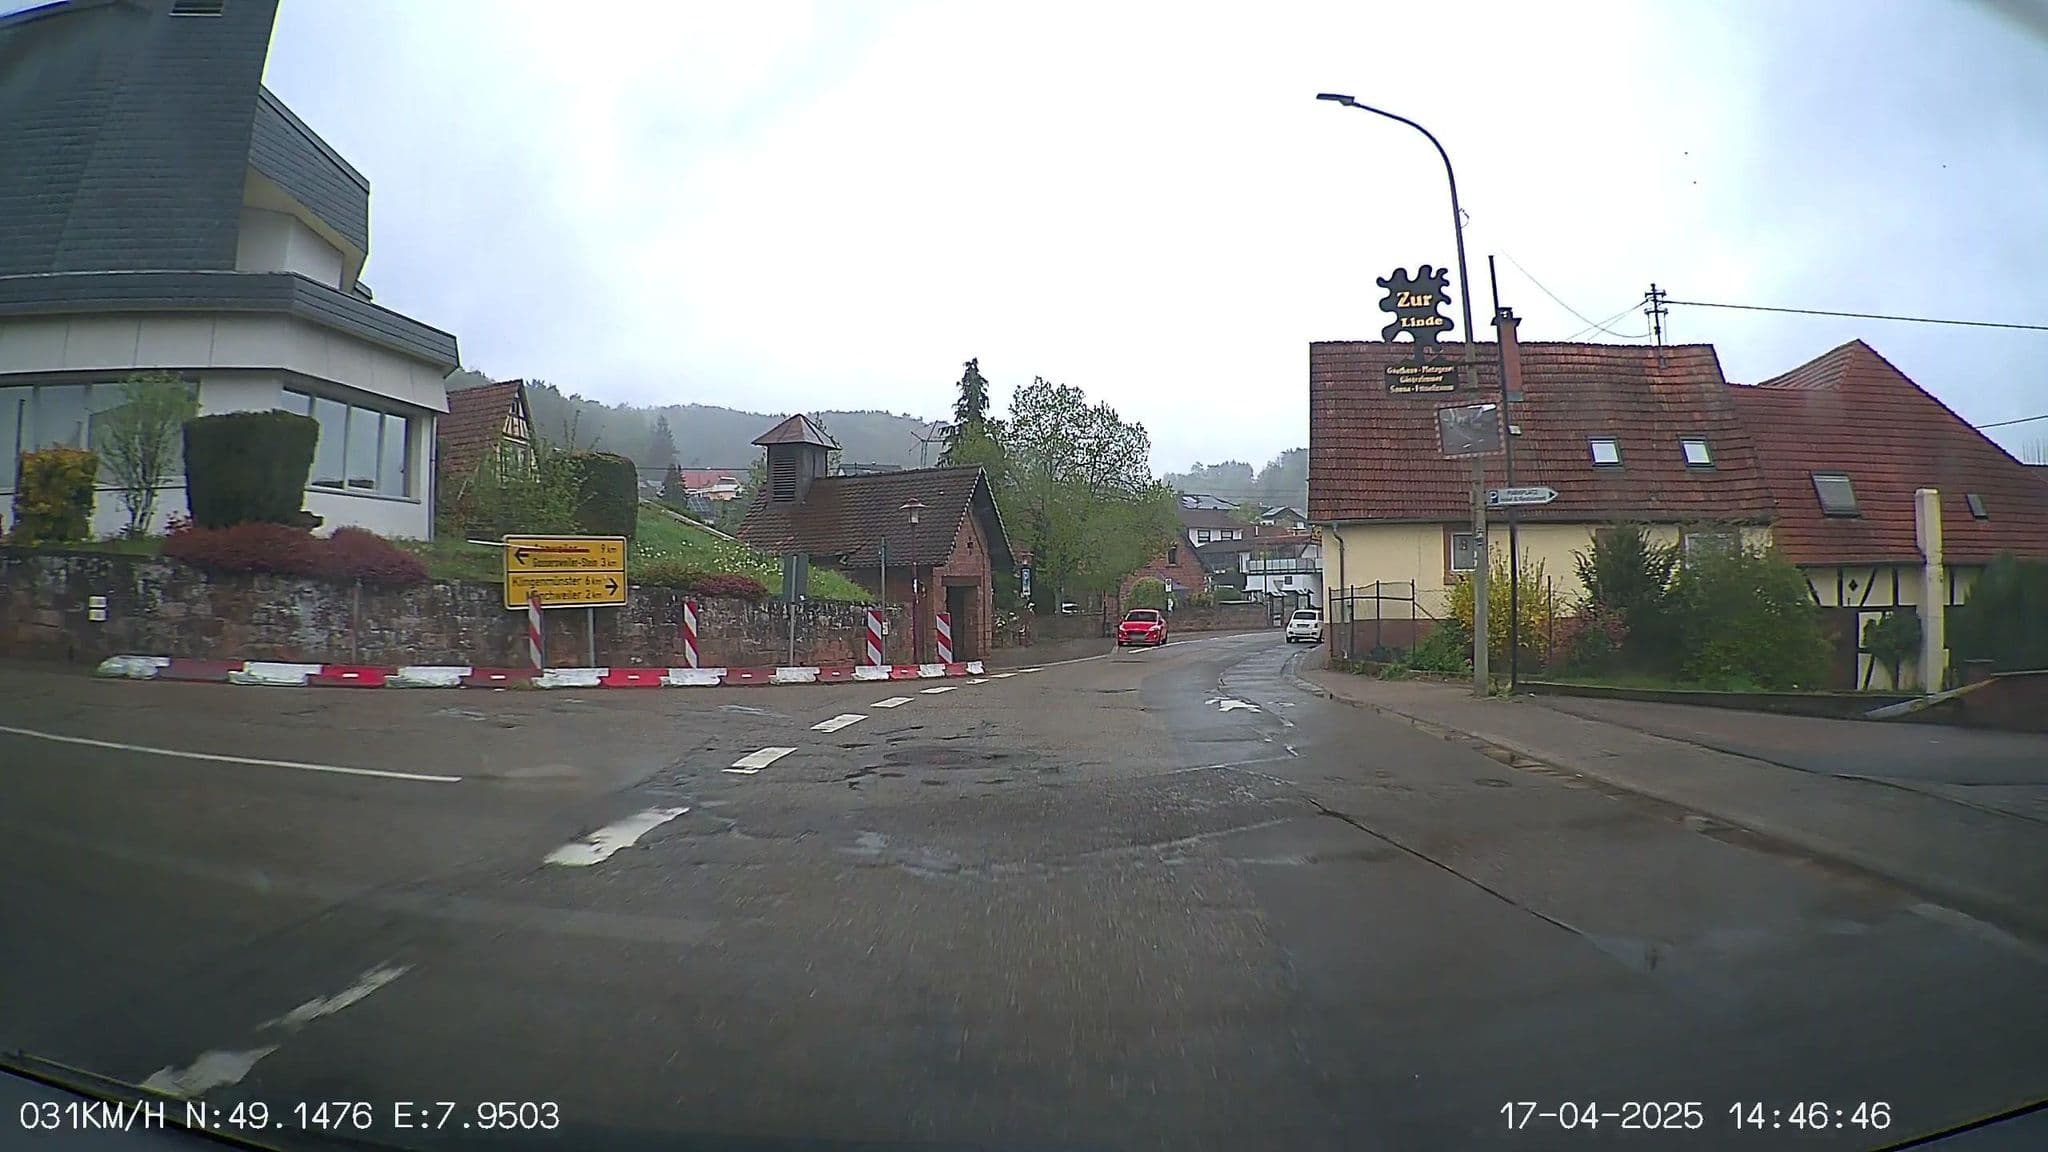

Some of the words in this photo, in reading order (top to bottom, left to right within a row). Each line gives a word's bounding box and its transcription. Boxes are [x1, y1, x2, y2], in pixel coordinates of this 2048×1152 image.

[1396, 291, 1432, 308] Zur
[1401, 316, 1443, 328] Linde
[607, 545, 617, 553] km
[600, 557, 606, 567] 3
[607, 559, 617, 567] km
[584, 575, 590, 586] 6
[591, 577, 602, 586] km
[525, 590, 582, 601] nchweiler
[584, 589, 592, 600] 2
[592, 591, 602, 600] km
